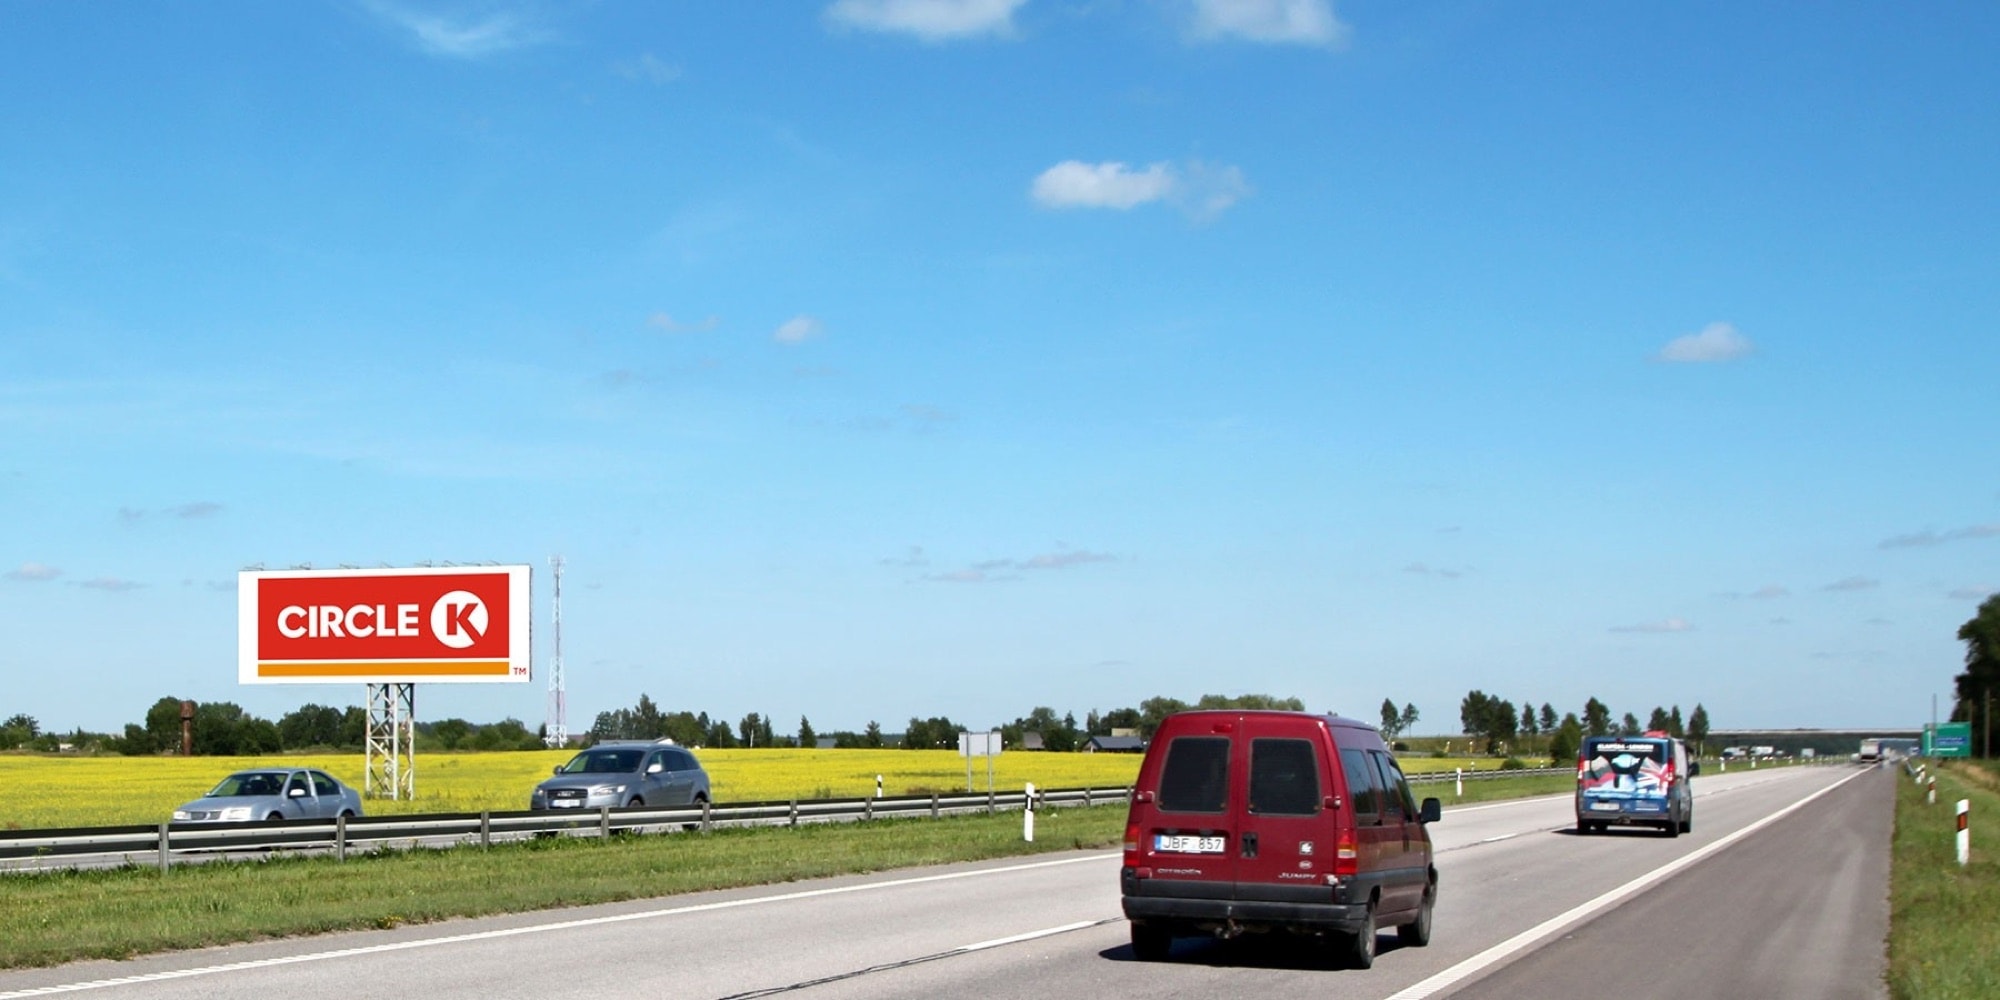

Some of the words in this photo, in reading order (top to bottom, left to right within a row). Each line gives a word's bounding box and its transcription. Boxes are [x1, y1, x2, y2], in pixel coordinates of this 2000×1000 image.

[277, 604, 419, 639] CIRCLE
[446, 602, 484, 645] K
[513, 667, 527, 676] TM
[1162, 837, 1190, 849] JBF
[1198, 838, 1222, 850] 857
